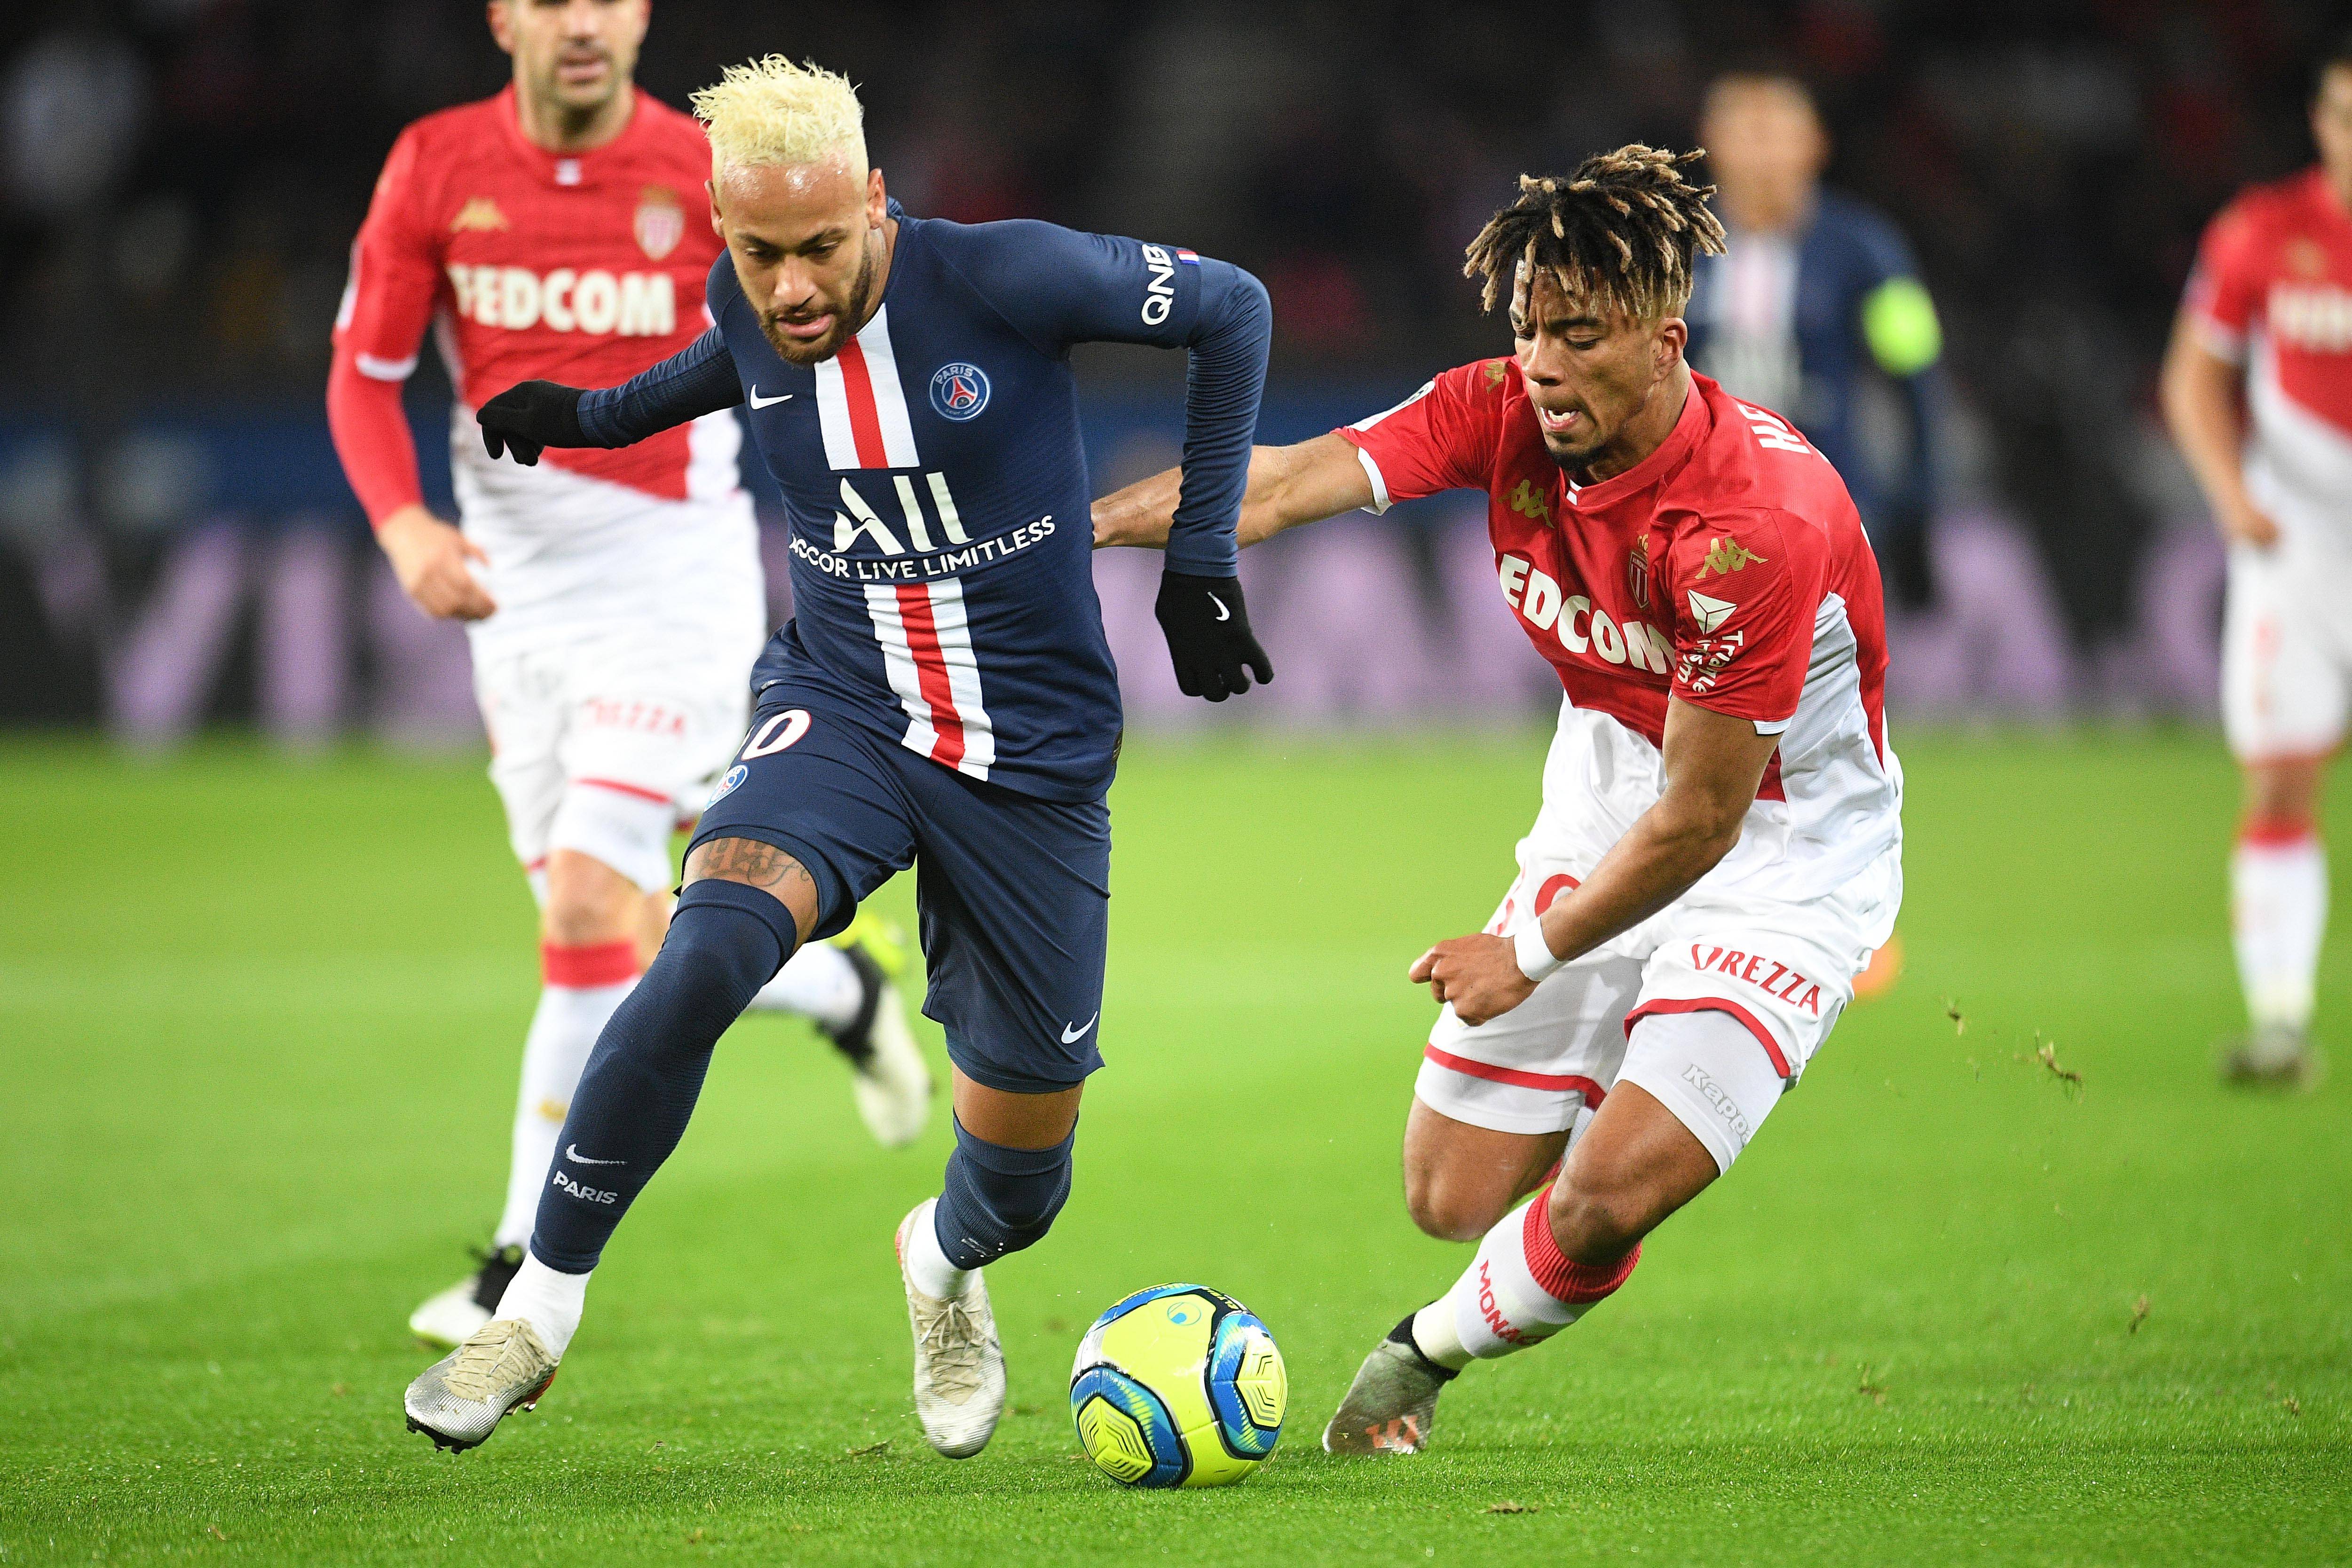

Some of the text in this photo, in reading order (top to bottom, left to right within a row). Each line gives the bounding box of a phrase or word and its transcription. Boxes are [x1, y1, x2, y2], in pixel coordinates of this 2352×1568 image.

[1141, 244, 1175, 325] QNB
[935, 365, 974, 385] PARIS
[789, 515, 1056, 580] ACCOR LIVE LIMITLESS
[1499, 553, 1677, 674] EDCOM
[737, 709, 813, 762] 0
[552, 1170, 618, 1204] PARIS
